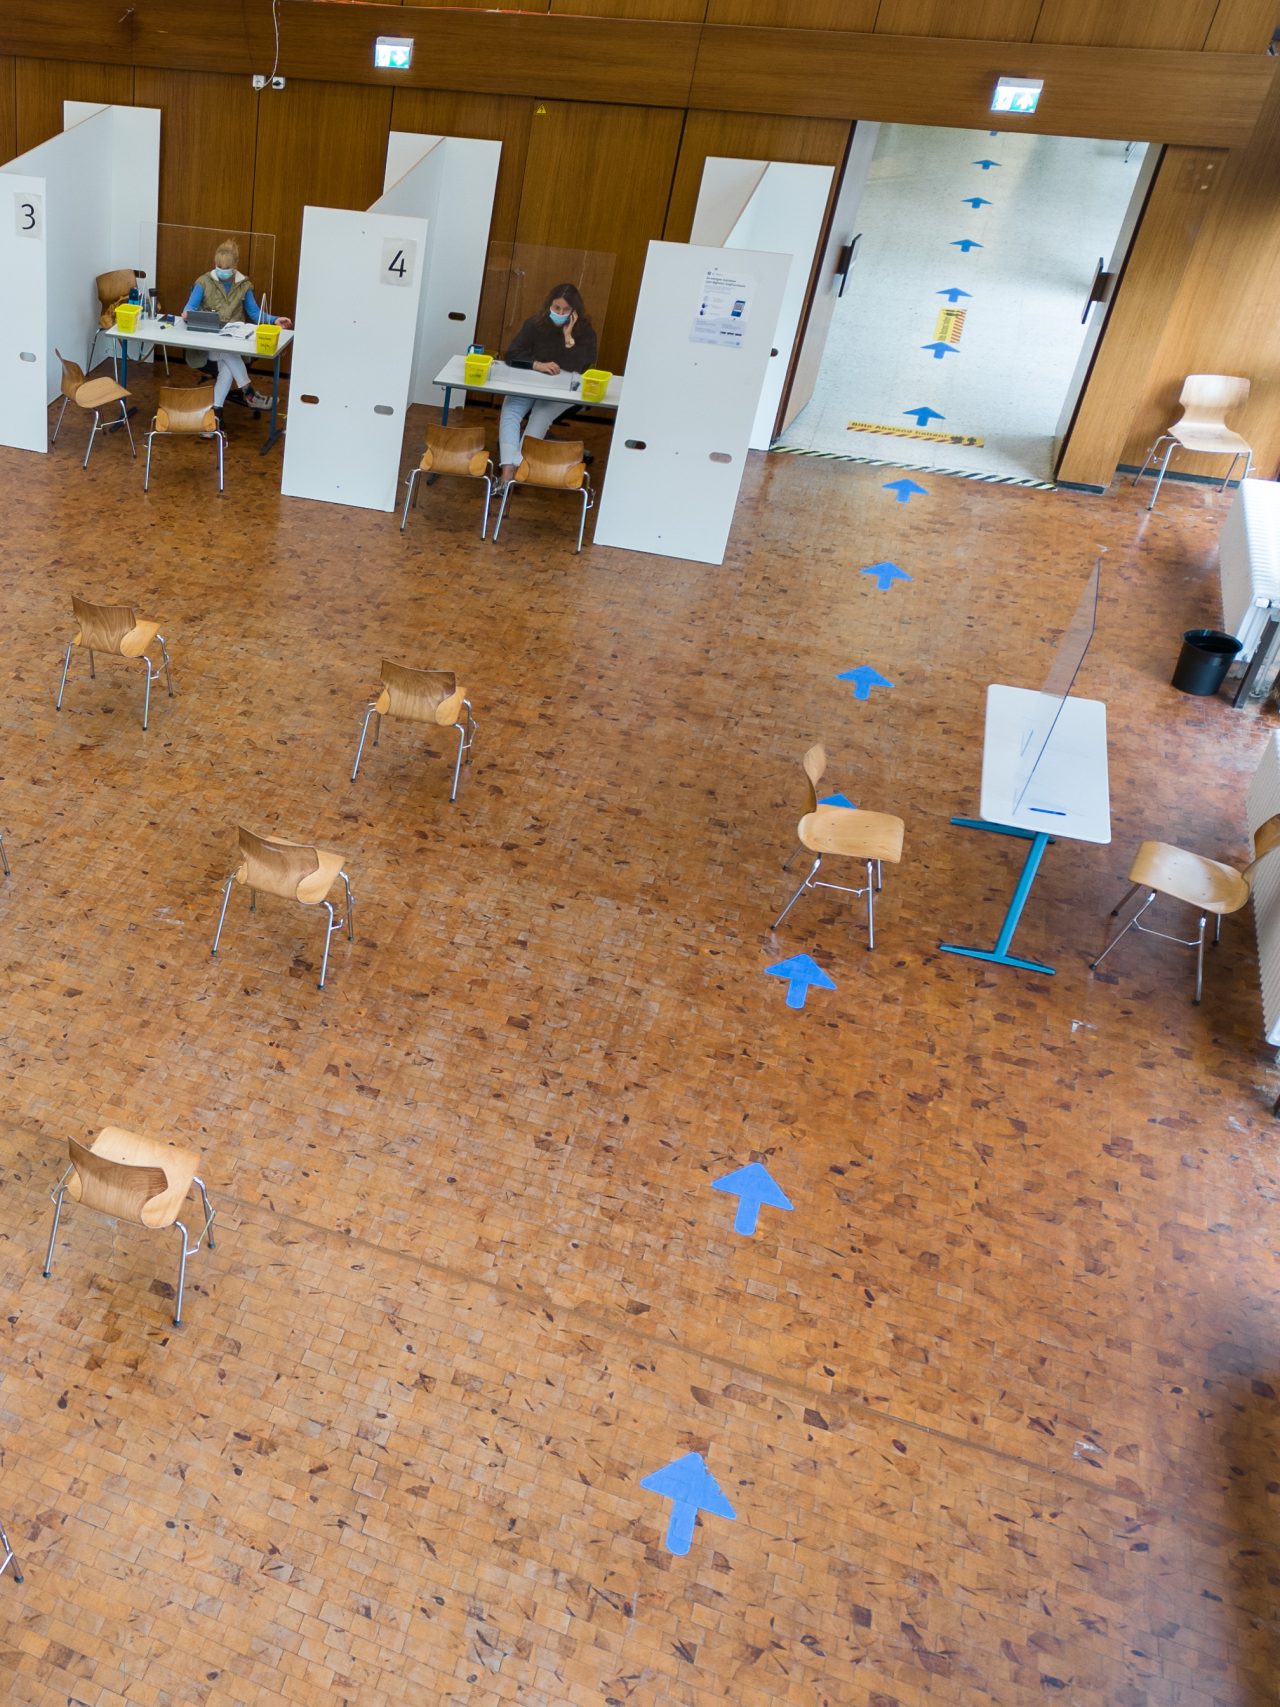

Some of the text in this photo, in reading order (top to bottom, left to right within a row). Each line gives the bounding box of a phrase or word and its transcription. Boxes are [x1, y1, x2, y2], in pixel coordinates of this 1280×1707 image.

[21, 203, 36, 230] 3
[388, 250, 407, 278] 4
[875, 425, 913, 433] Abstand
